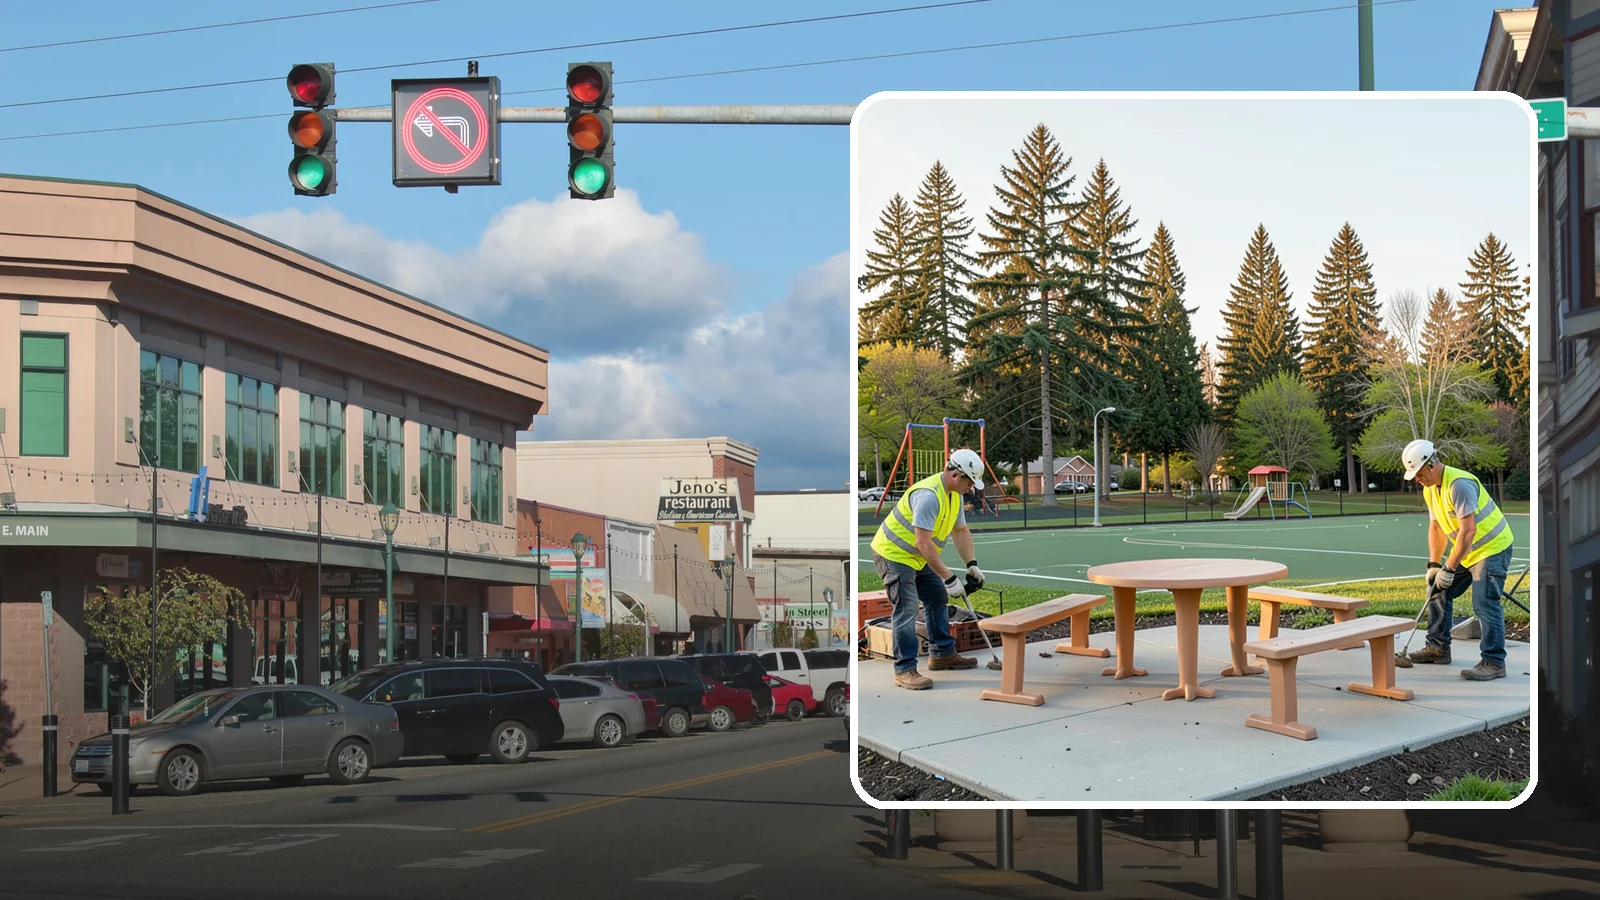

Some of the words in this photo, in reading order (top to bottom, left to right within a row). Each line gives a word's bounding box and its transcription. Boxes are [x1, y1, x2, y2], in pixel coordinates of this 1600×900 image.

[670, 480, 727, 494] Jeno's
[665, 496, 731, 509] restaurant
[686, 509, 714, 519] American
[715, 509, 737, 519] Cuisine
[2, 525, 13, 536] E.
[15, 525, 49, 536] MAIN
[797, 607, 828, 616] Street
[791, 619, 823, 627] lass
